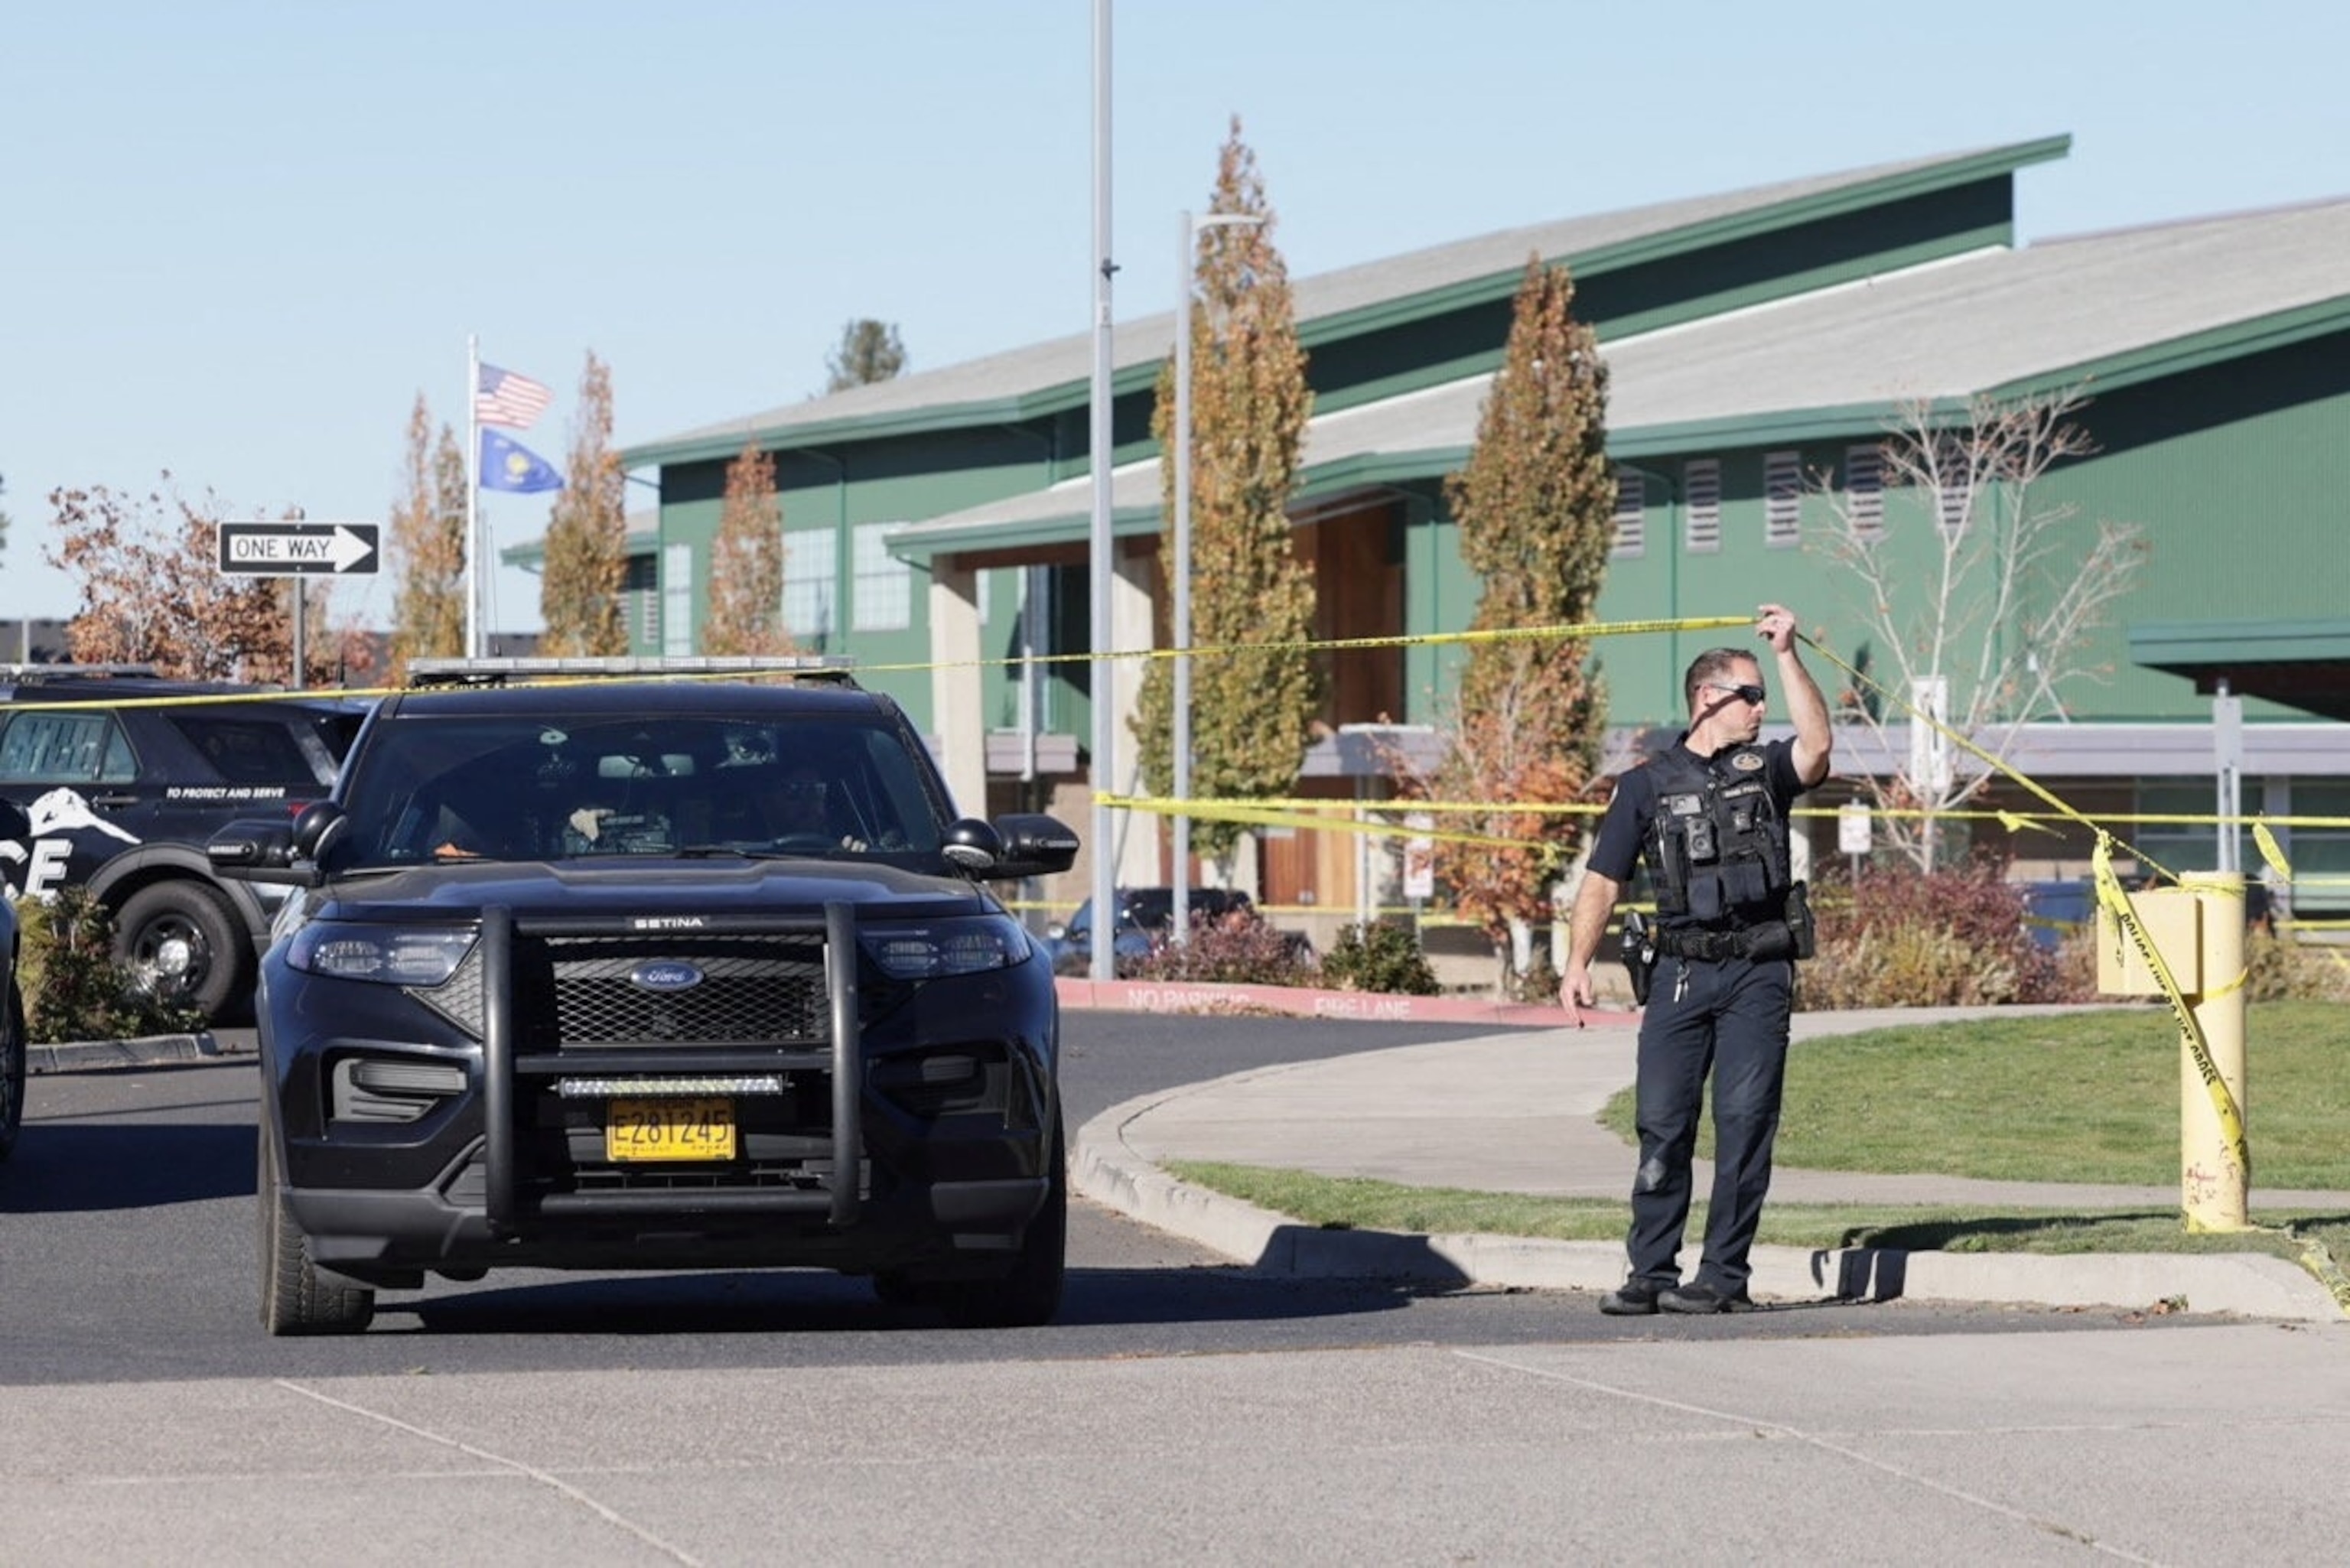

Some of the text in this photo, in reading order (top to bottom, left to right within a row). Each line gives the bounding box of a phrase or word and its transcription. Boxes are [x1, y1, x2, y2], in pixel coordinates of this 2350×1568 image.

[236, 538, 330, 558] ONE WAY
[166, 786, 285, 799] TO PROTECT AND SERVE
[633, 917, 704, 929] SETINA
[647, 967, 687, 983] Ford
[1128, 988, 1160, 1009] NO
[1315, 997, 1411, 1019] FIRE LANE
[614, 1110, 728, 1144] E281245
